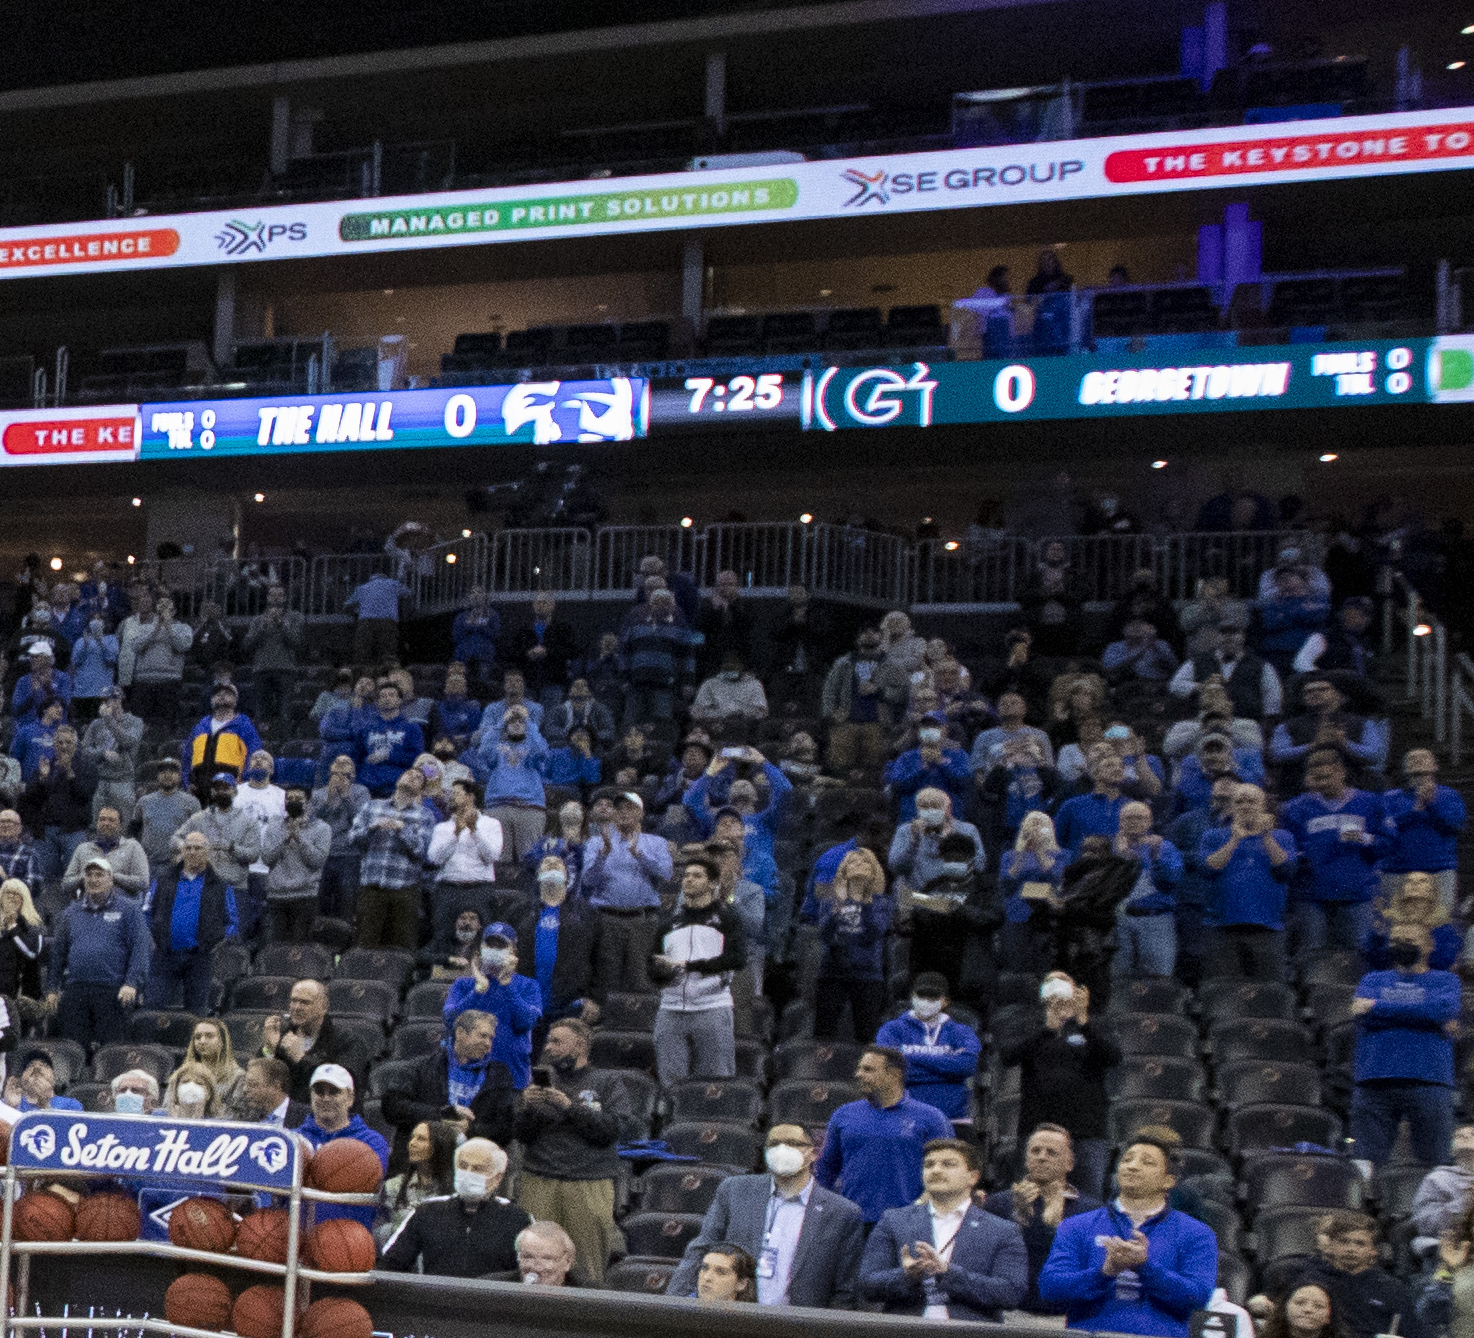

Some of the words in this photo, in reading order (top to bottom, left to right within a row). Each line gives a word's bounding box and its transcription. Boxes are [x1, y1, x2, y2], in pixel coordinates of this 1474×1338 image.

[1143, 151, 1206, 173] THE
[1221, 135, 1409, 168] KEYSTONE
[1423, 131, 1470, 151] TO
[369, 209, 499, 235] MANAGED
[511, 200, 595, 222] PRINT
[605, 187, 771, 215] SOLUTIONS
[685, 373, 785, 414] 7:25
[993, 364, 1036, 412] 0
[33, 428, 84, 447] THE
[258, 405, 316, 446] THE
[315, 400, 394, 442] HALL
[444, 393, 477, 437] 0
[61, 1123, 151, 1171] Seton
[153, 1129, 249, 1176] Hall
